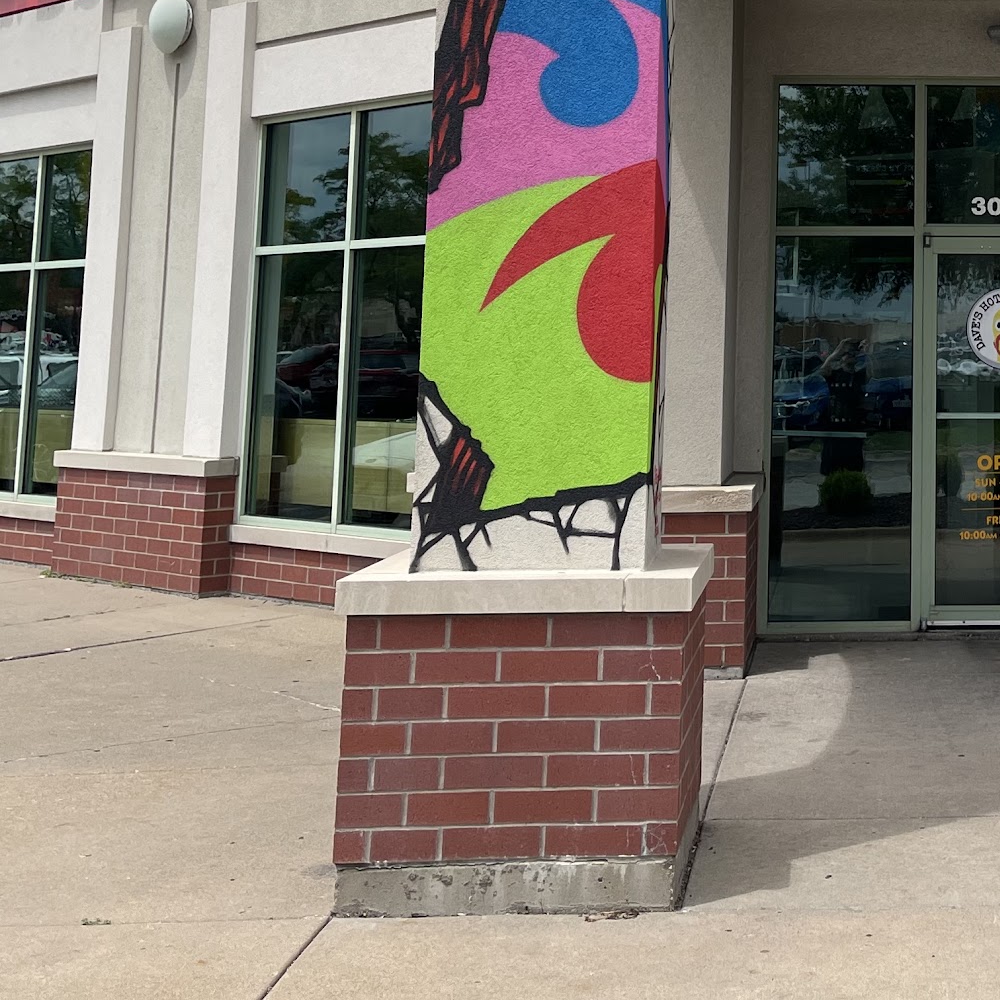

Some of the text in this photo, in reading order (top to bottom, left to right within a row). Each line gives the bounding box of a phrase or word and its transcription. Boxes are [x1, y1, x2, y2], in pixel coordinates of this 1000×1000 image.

[971, 311, 986, 350] DAVE'S
[979, 294, 1000, 312] HOT
[975, 478, 996, 487] SUN
[960, 530, 997, 540] 10:00AM
